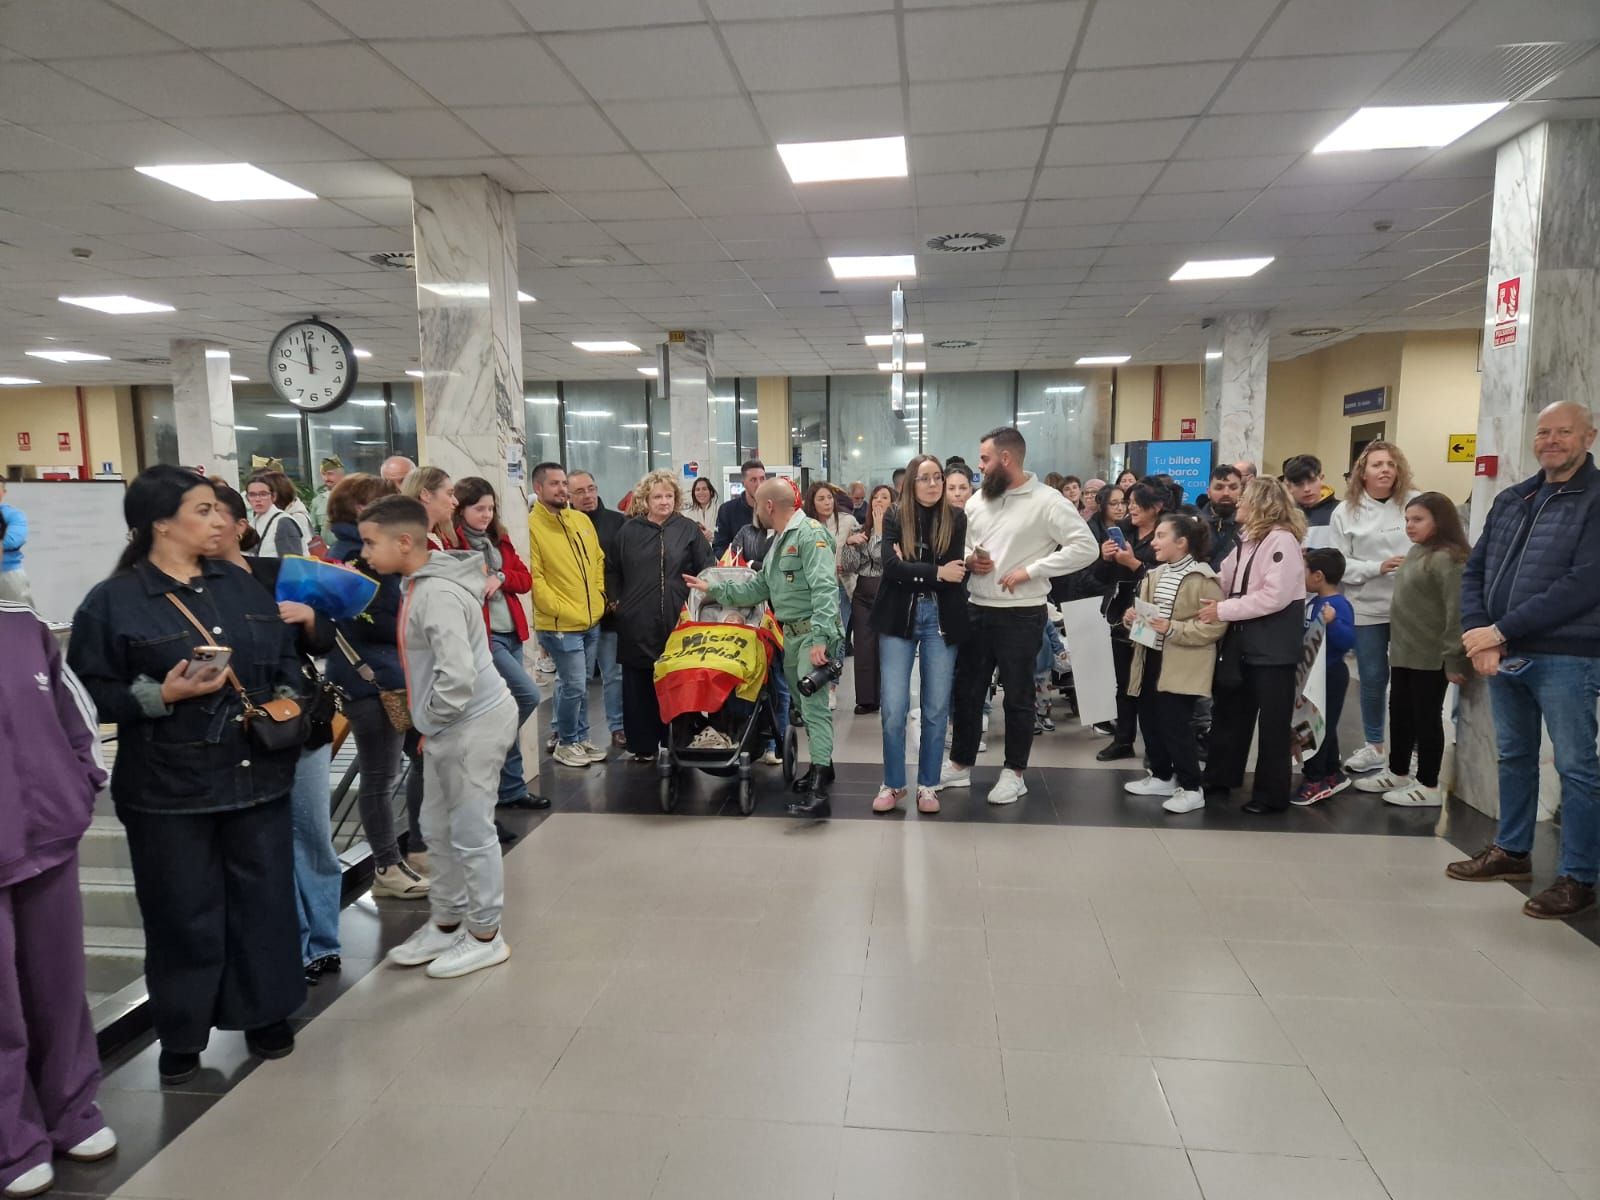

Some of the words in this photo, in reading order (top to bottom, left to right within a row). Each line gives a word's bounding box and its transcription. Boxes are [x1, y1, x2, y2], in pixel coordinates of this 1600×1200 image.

[303, 331, 314, 340] 12
[289, 337, 299, 345] 11
[281, 349, 292, 358] 10
[331, 345, 339, 354] 2
[278, 363, 287, 372] 9
[336, 361, 344, 370] 3
[284, 377, 292, 386] 8
[333, 376, 342, 384] 4
[296, 389, 304, 398] 7
[324, 388, 333, 396] 5
[310, 393, 318, 401] 6
[1154, 456, 1166, 464] Tu
[1168, 456, 1201, 464] billete
[1168, 468, 1199, 476] barco
